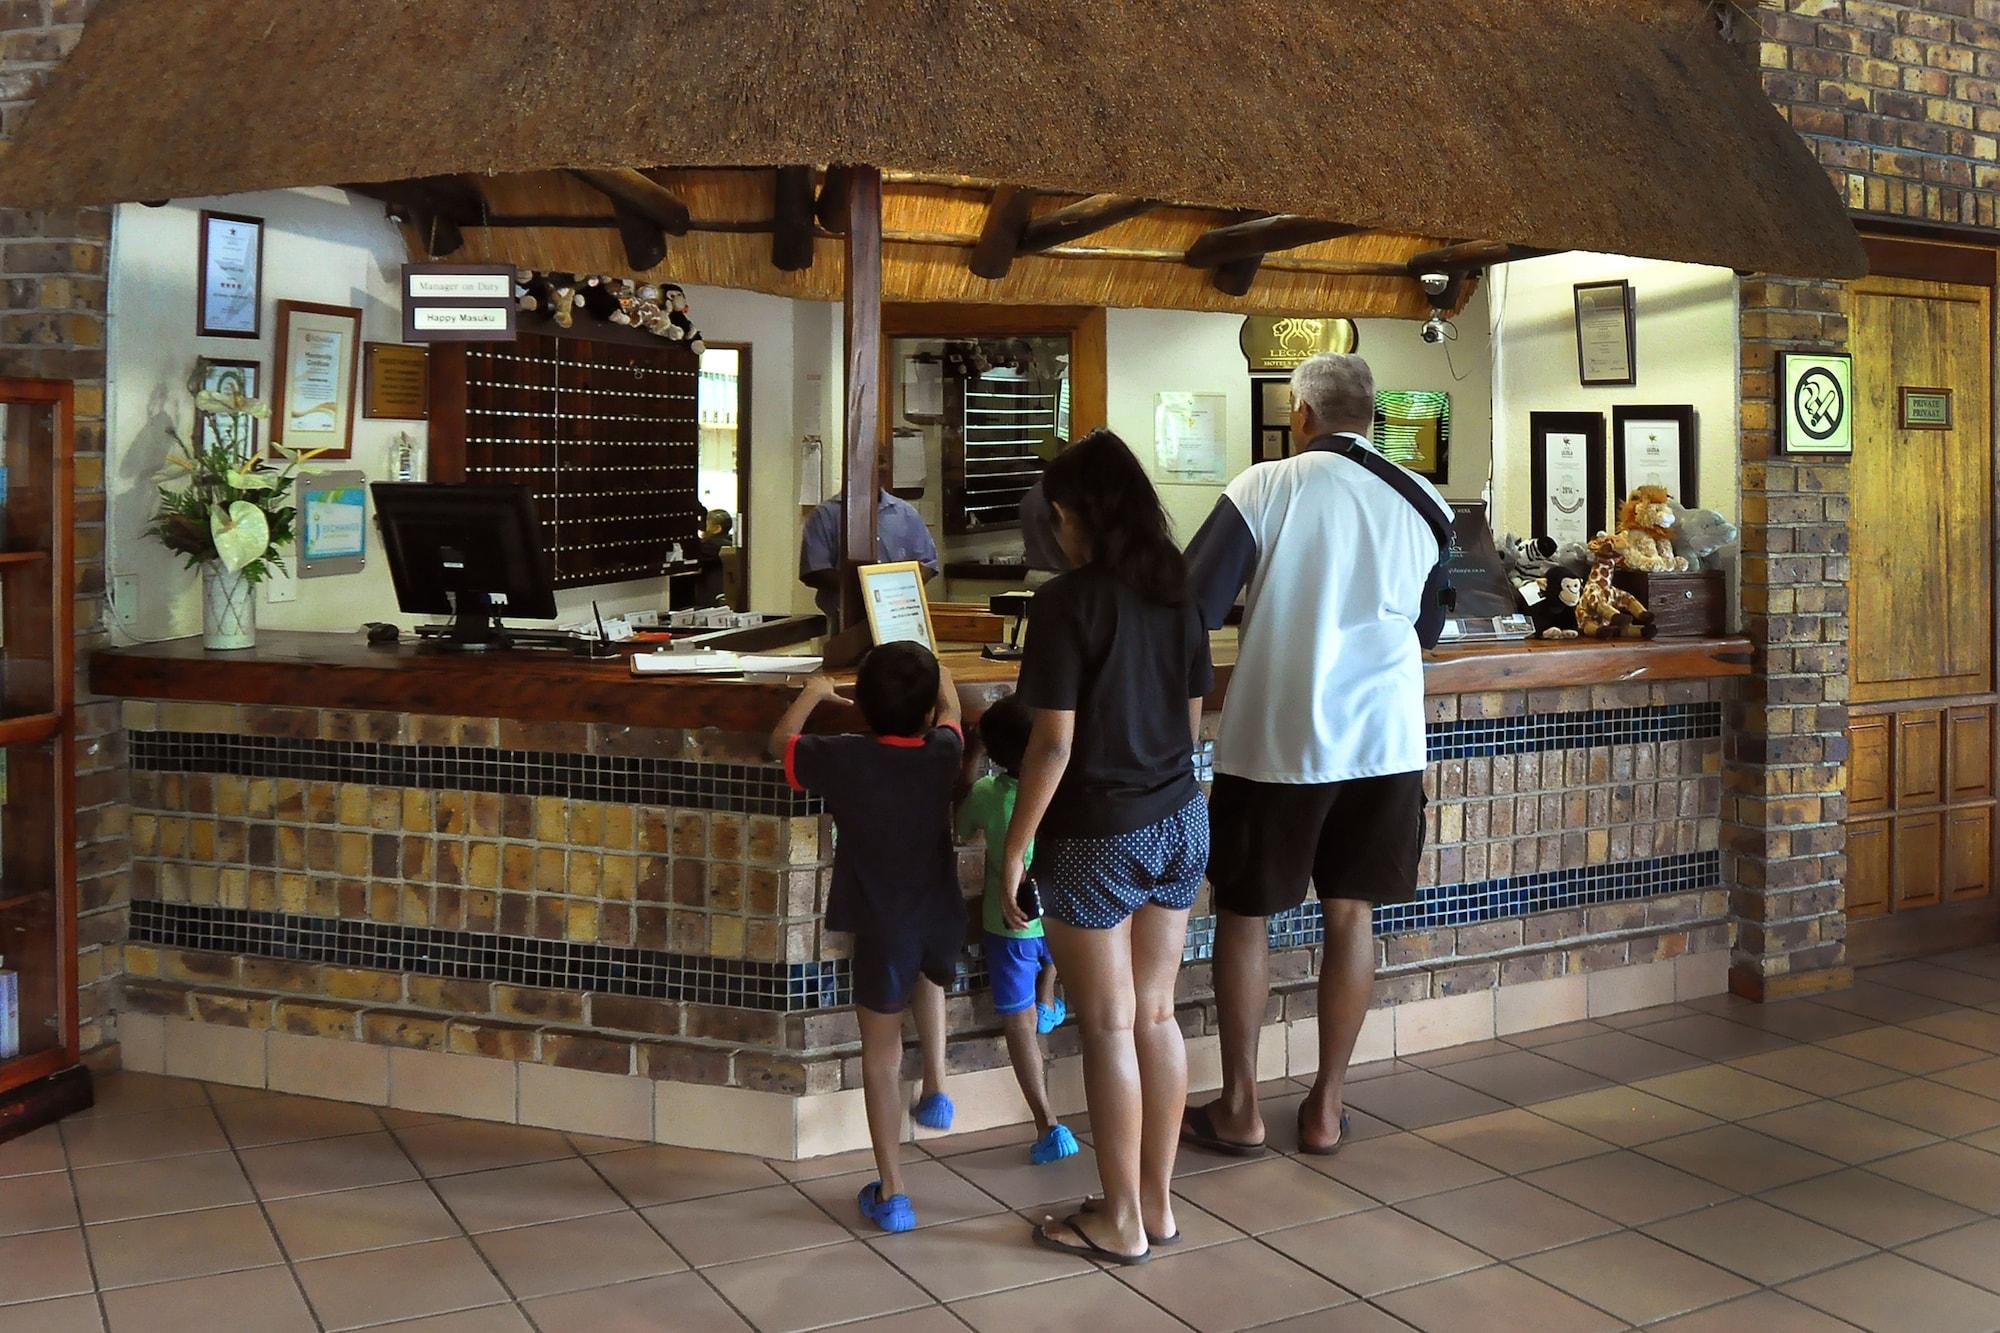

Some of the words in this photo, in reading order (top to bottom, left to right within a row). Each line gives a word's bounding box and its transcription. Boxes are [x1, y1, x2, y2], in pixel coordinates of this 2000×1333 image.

[420, 282, 458, 291] Manager
[478, 282, 499, 291] Duty
[427, 314, 457, 322] Happy
[459, 314, 495, 322] Masuku
[1270, 349, 1321, 357] LEGAC
[1913, 399, 1939, 408] PRIVATE
